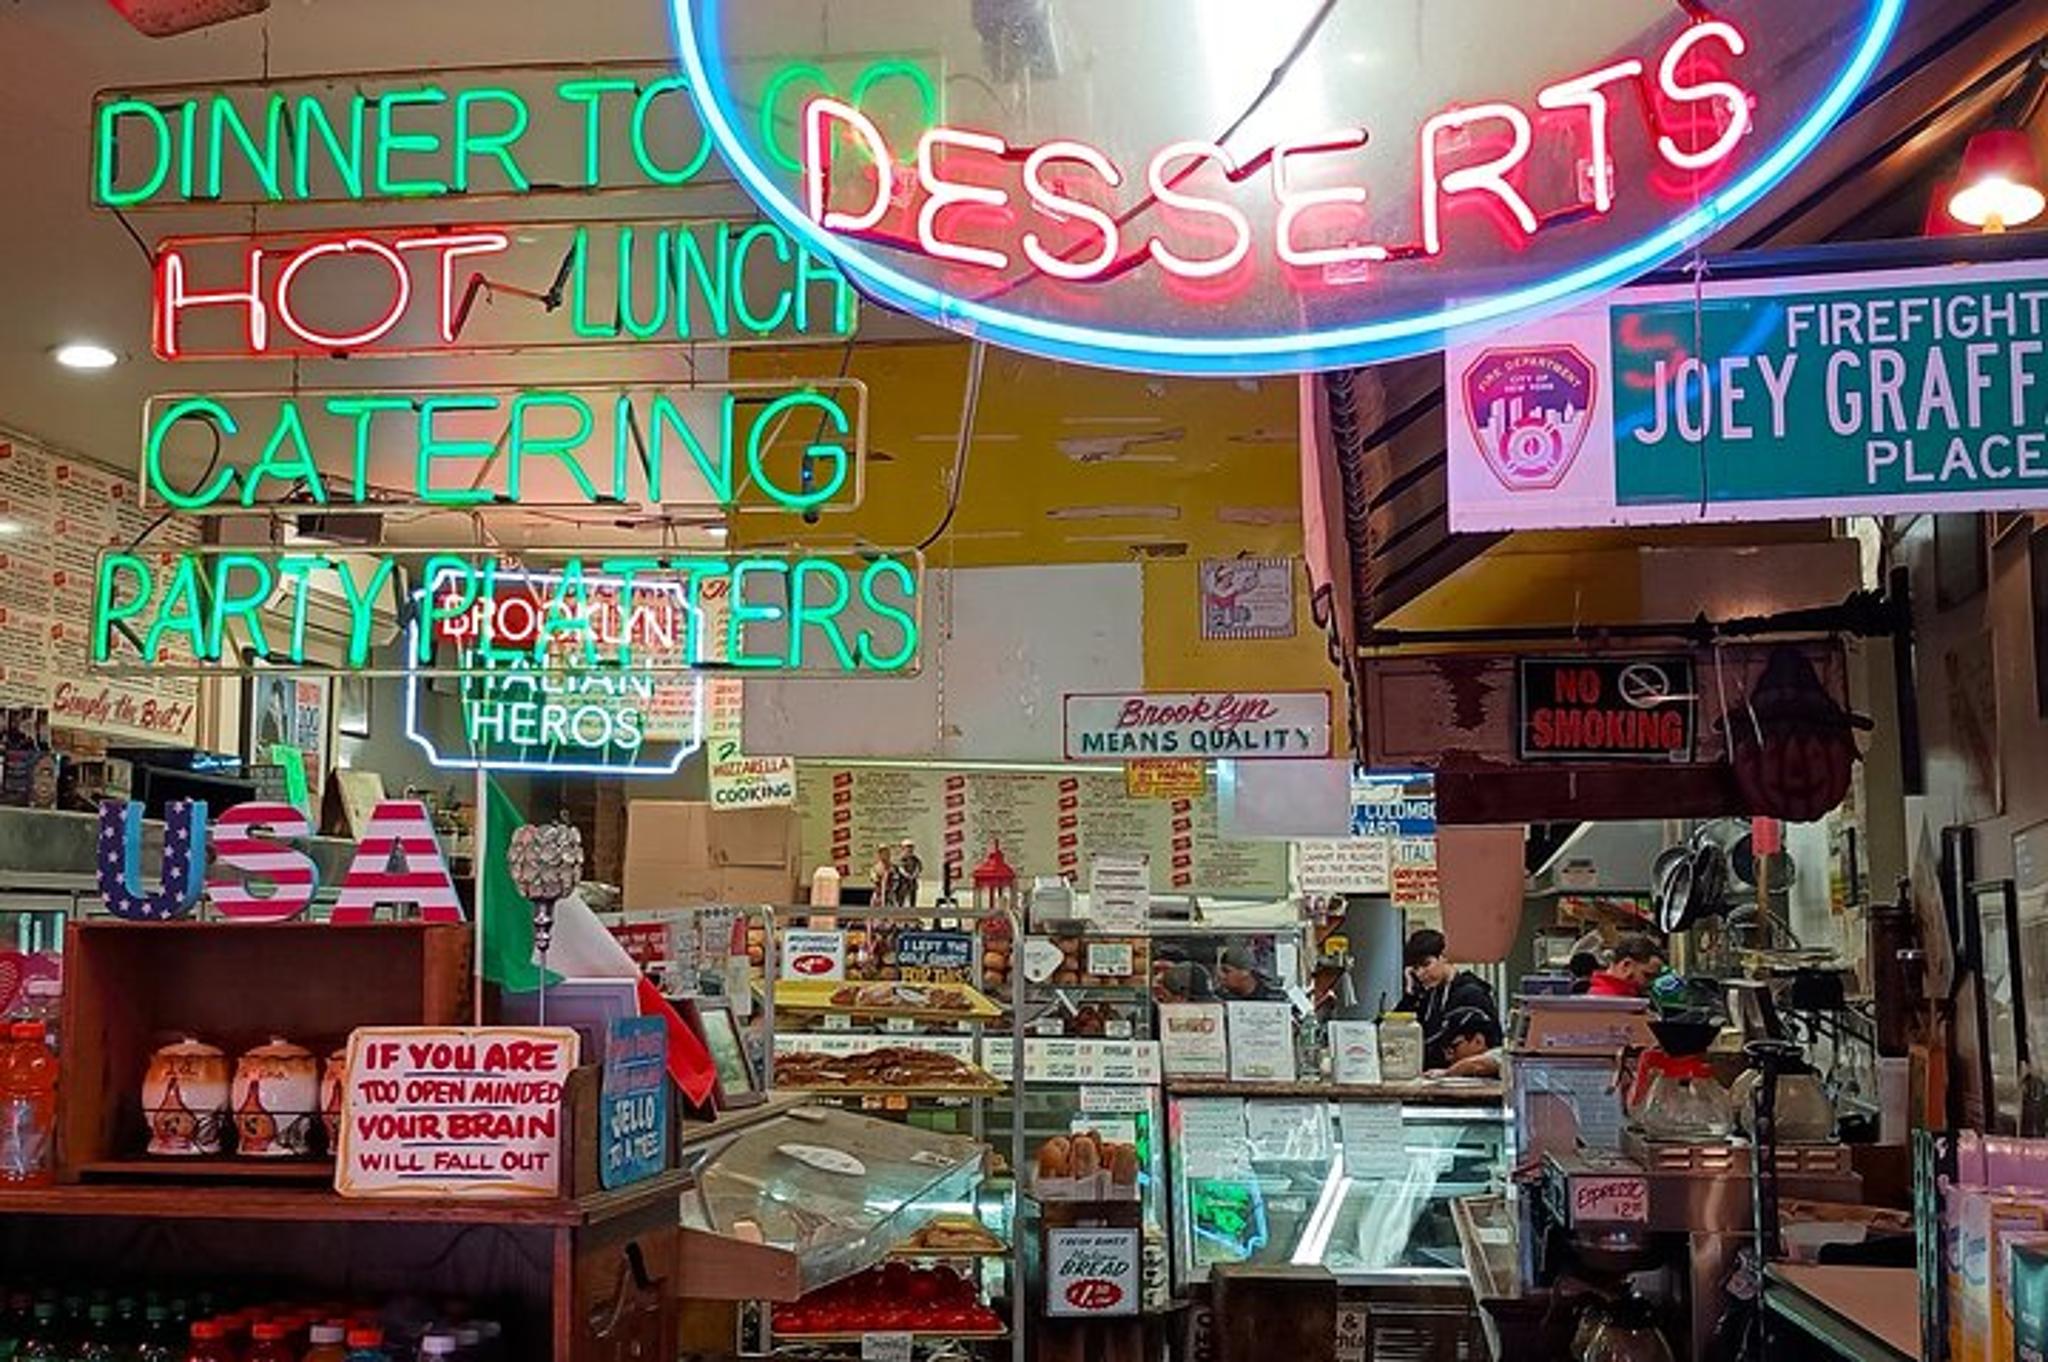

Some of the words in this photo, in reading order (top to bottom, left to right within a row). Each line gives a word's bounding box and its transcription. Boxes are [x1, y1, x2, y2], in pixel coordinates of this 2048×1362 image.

[101, 87, 531, 206] DINNER
[558, 78, 714, 187] TO
[804, 18, 1754, 282] DESSERTS
[158, 233, 508, 357] HOT
[571, 223, 852, 340] LUNCH
[1786, 290, 2048, 348] FIREFIGHT
[1634, 353, 1798, 444] JOEY
[1826, 340, 2048, 436] GRAFF
[148, 390, 851, 510] CATERING
[1866, 432, 2048, 485] PLACE
[93, 551, 395, 669] PARTY
[417, 552, 920, 672] PLATTERS
[441, 594, 676, 649] BROOKLYN
[465, 648, 654, 699] ITALIAN
[1554, 668, 1601, 704] NO
[54, 681, 110, 725] Simply
[116, 690, 134, 722] the
[470, 700, 643, 749] HEROS
[1117, 693, 1278, 731] Brooklyn
[1081, 729, 1179, 753] MEANS
[1190, 727, 1315, 751] QUALITY
[1532, 707, 1683, 749] SMOKING
[715, 781, 792, 804] COOKING
[99, 797, 468, 923] USA
[366, 1043, 400, 1070] IF
[408, 1042, 476, 1070] YOU
[483, 1040, 558, 1072] ARE
[358, 1080, 399, 1104] TOO
[405, 1080, 465, 1104] OPEN
[470, 1080, 563, 1104] MINDED
[358, 1114, 443, 1140] YOUR
[446, 1109, 556, 1140] BRAIN
[611, 1094, 655, 1139] JELLO
[360, 1153, 424, 1171] WILL
[434, 1153, 494, 1171] FALL
[501, 1151, 550, 1171] OUT
[1578, 1182, 1645, 1209] ESPRESSO
[1058, 1260, 1131, 1277] BREAD
